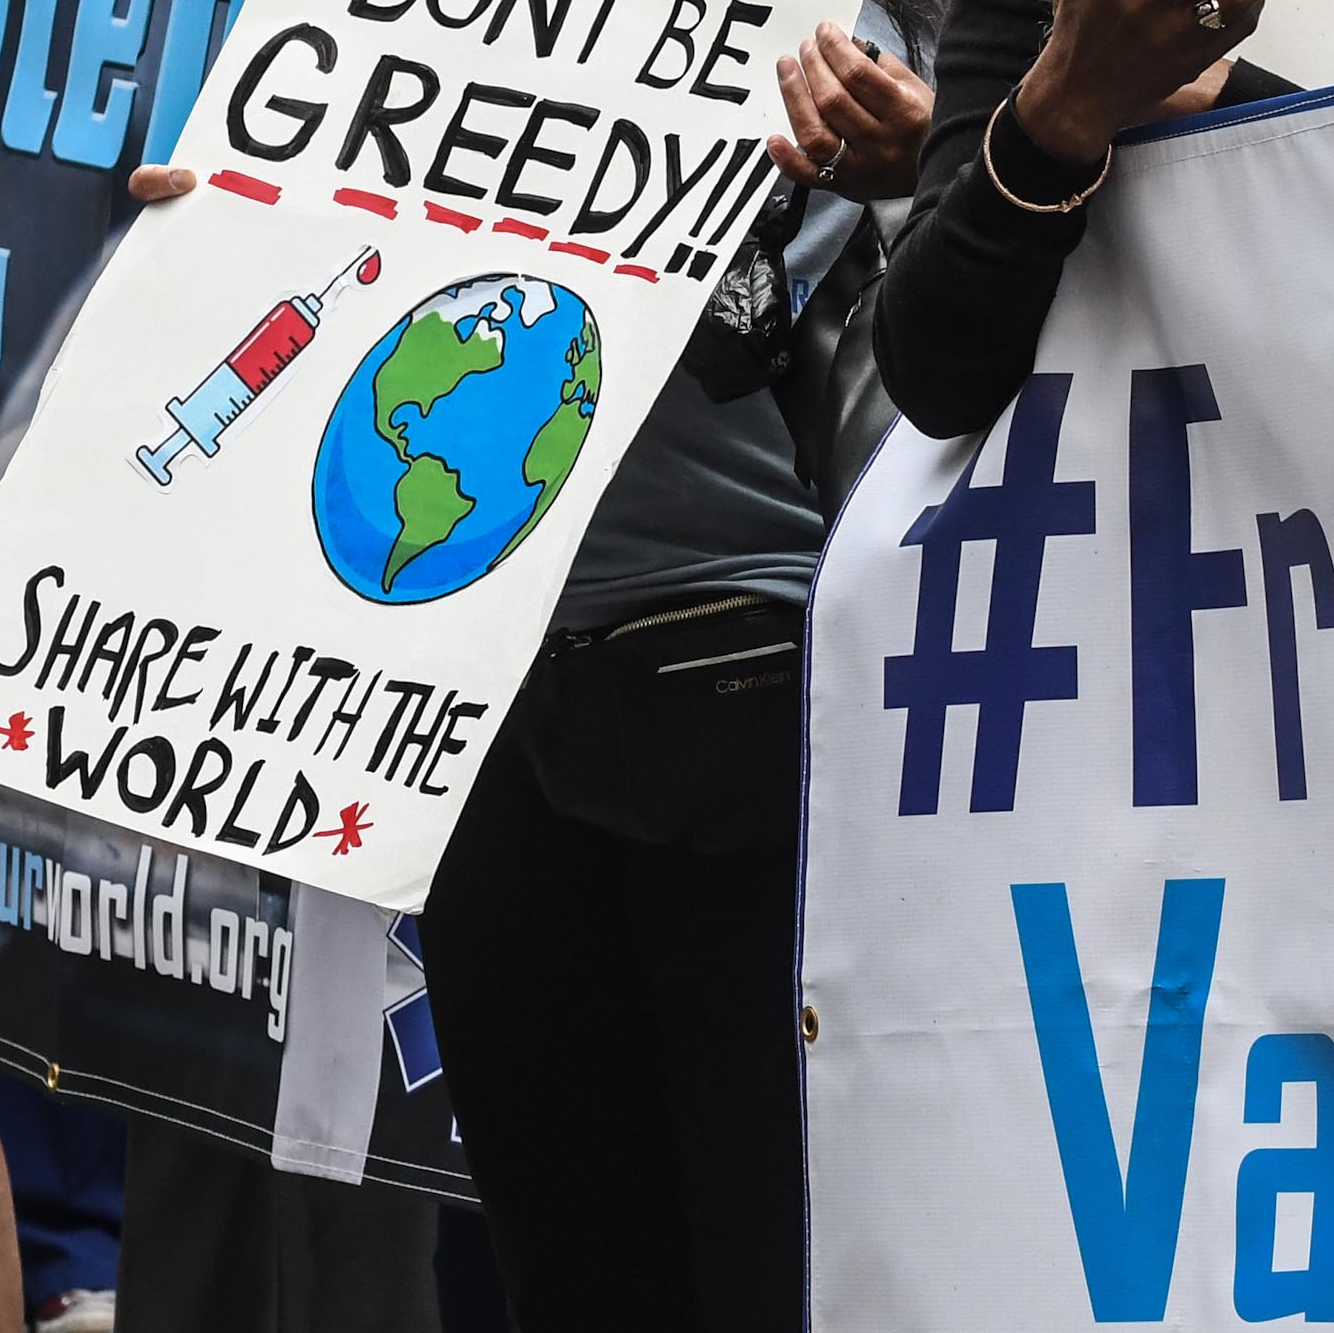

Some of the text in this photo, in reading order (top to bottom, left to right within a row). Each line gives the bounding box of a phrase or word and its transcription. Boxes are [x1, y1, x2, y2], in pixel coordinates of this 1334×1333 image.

[46, 707, 320, 855] WORLD
[209, 645, 375, 761] WITH
[365, 680, 488, 795] THE
